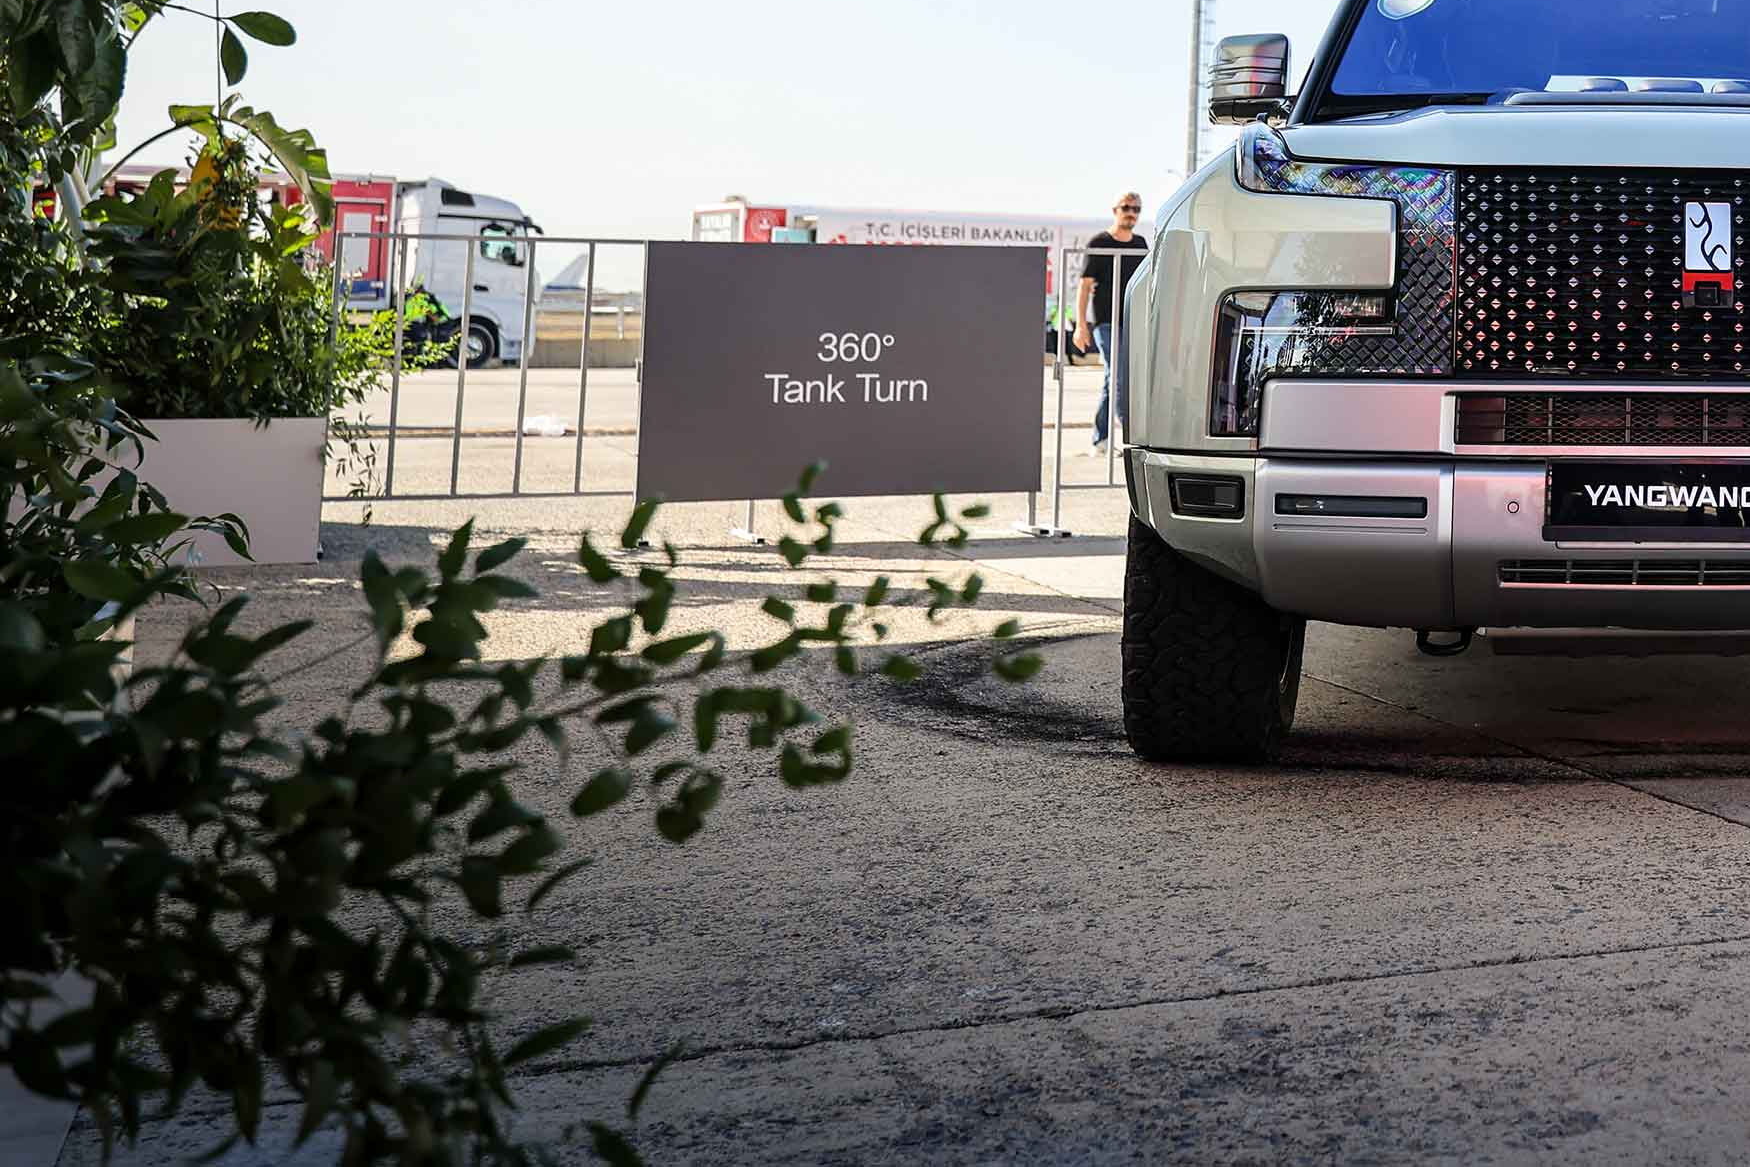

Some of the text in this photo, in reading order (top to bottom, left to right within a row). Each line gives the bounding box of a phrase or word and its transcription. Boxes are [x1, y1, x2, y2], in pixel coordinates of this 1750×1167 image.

[864, 222, 1055, 244] T.C. İÇİŞLERİ BAKANLIĞI
[817, 332, 896, 362] 360°
[764, 373, 928, 403] Tank Turn
